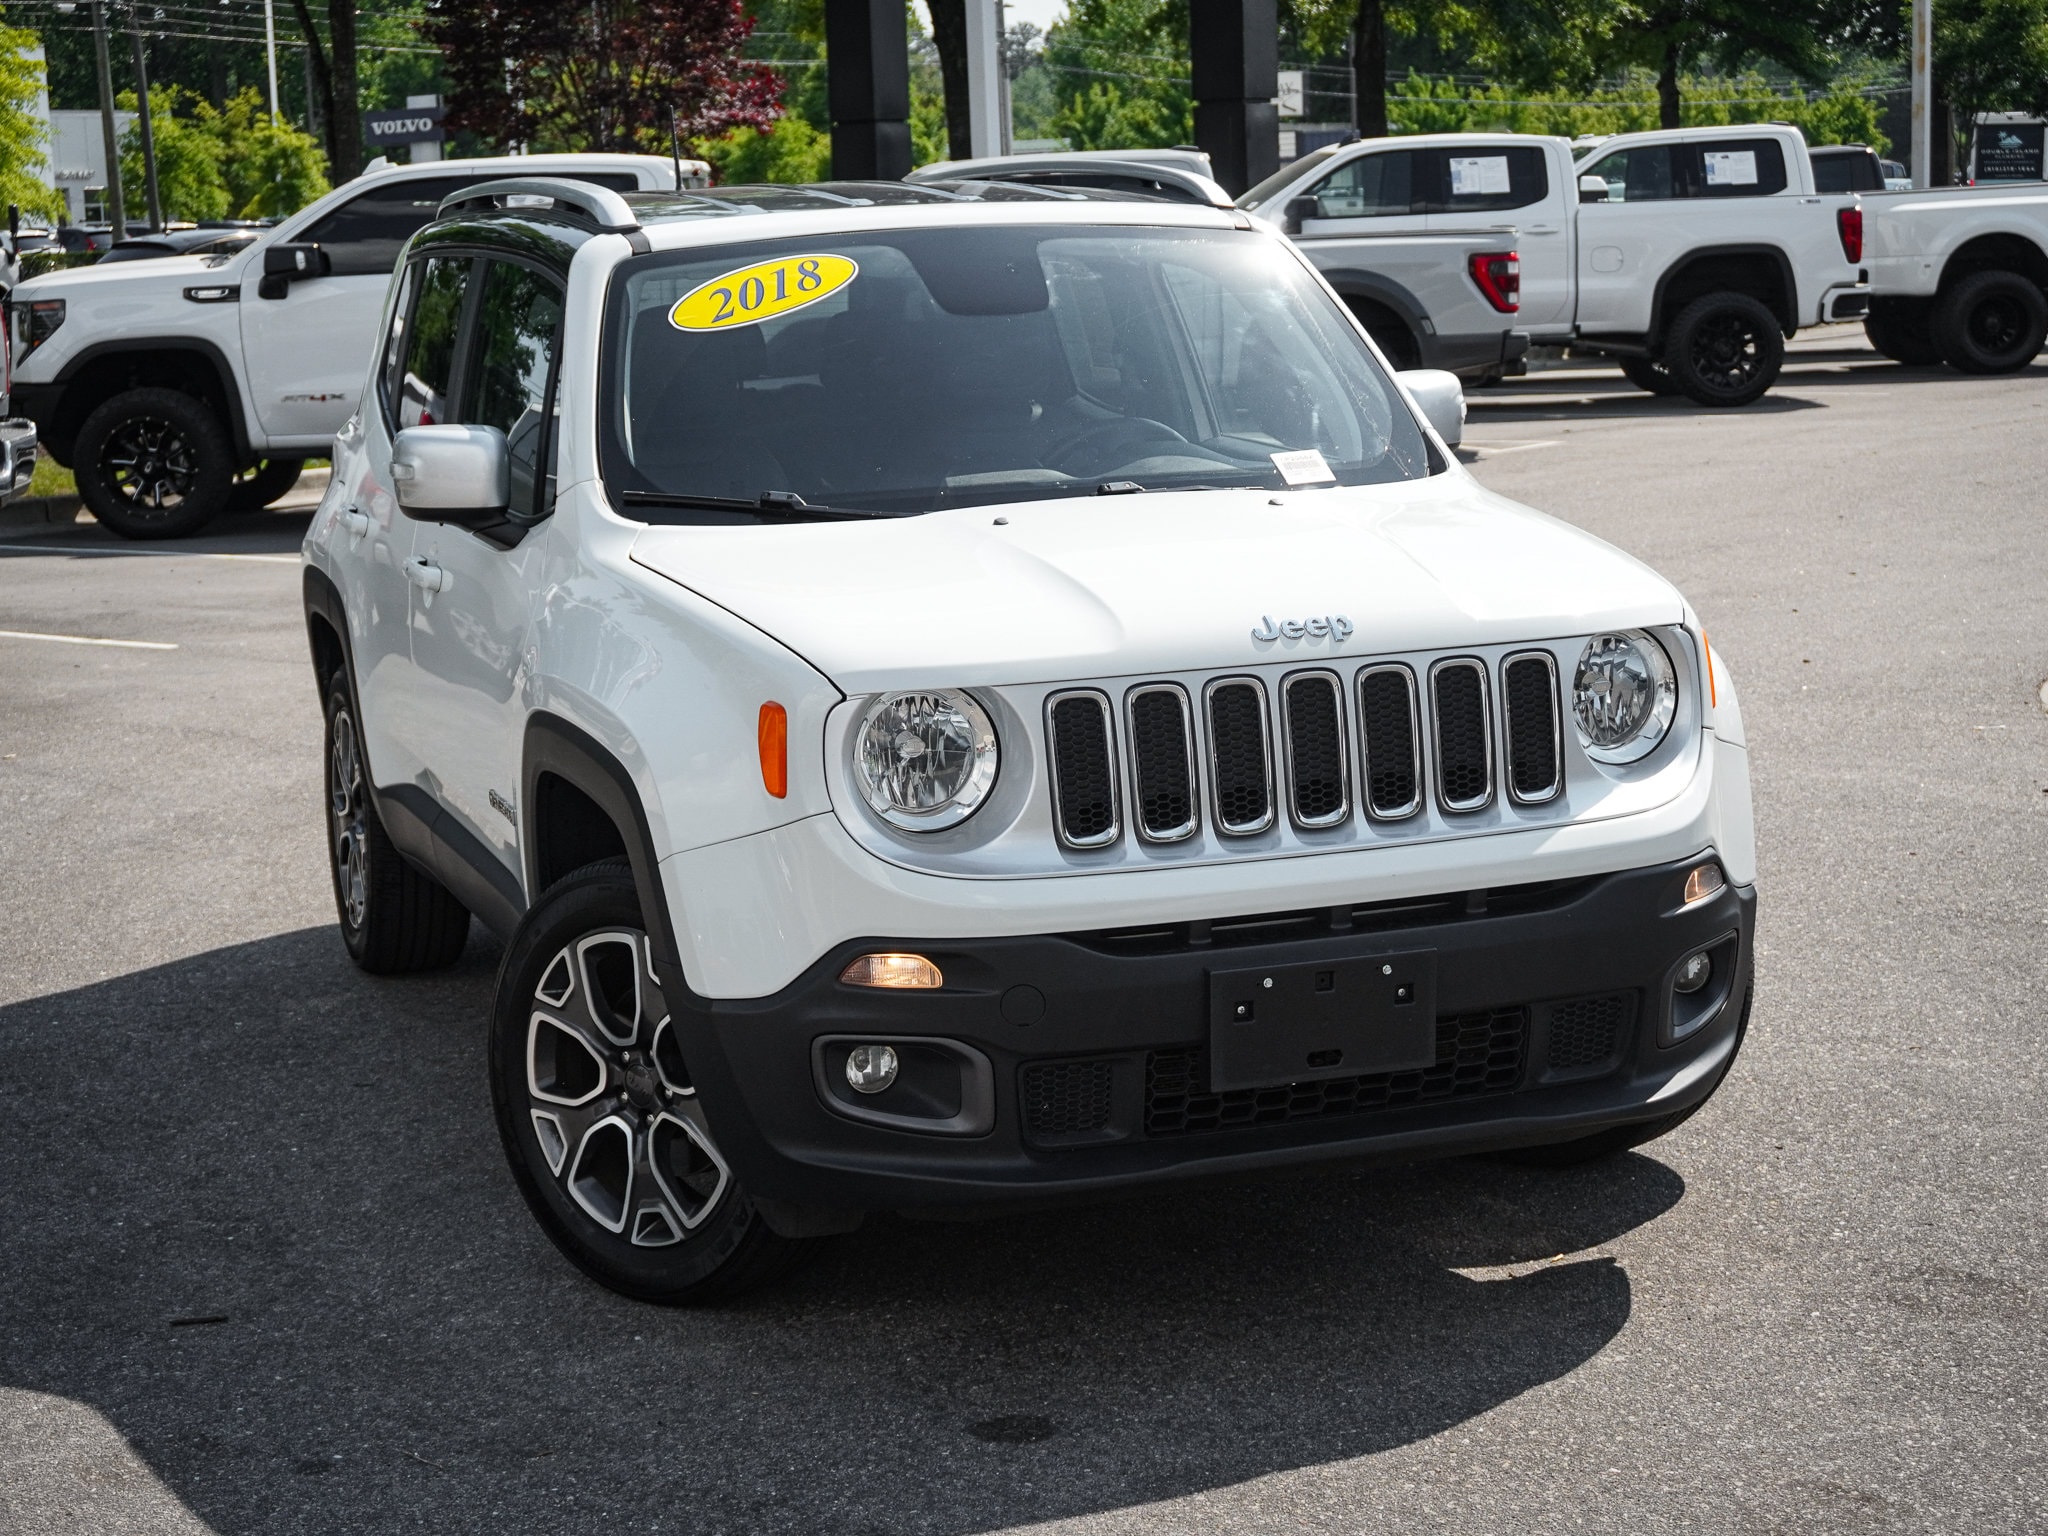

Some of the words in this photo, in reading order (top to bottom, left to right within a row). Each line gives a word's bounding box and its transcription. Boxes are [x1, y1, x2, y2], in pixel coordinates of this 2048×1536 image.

[370, 118, 433, 136] VOLVO
[709, 259, 822, 324] 2018
[1250, 614, 1354, 643] Jeep
